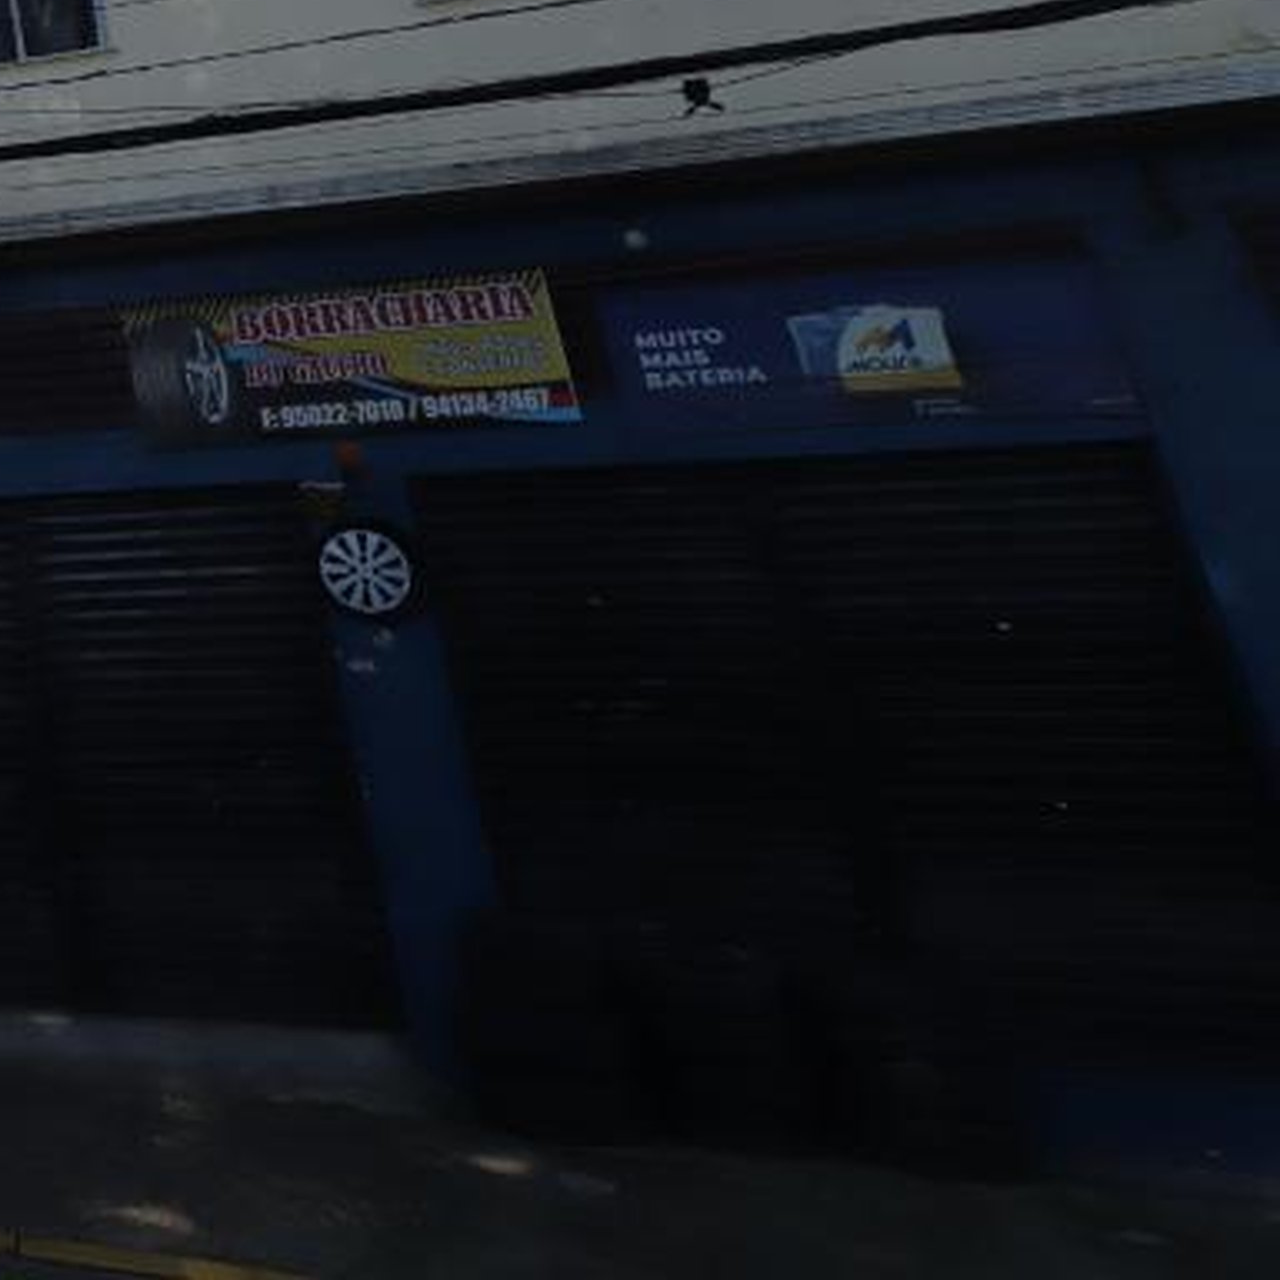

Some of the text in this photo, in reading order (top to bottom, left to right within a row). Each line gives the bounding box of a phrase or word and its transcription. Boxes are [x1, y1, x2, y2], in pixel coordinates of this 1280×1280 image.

[233, 284, 533, 343] BORRACHARIA
[633, 327, 724, 348] MUITO
[639, 350, 711, 369] MAIS
[645, 366, 769, 390] BATERIA
